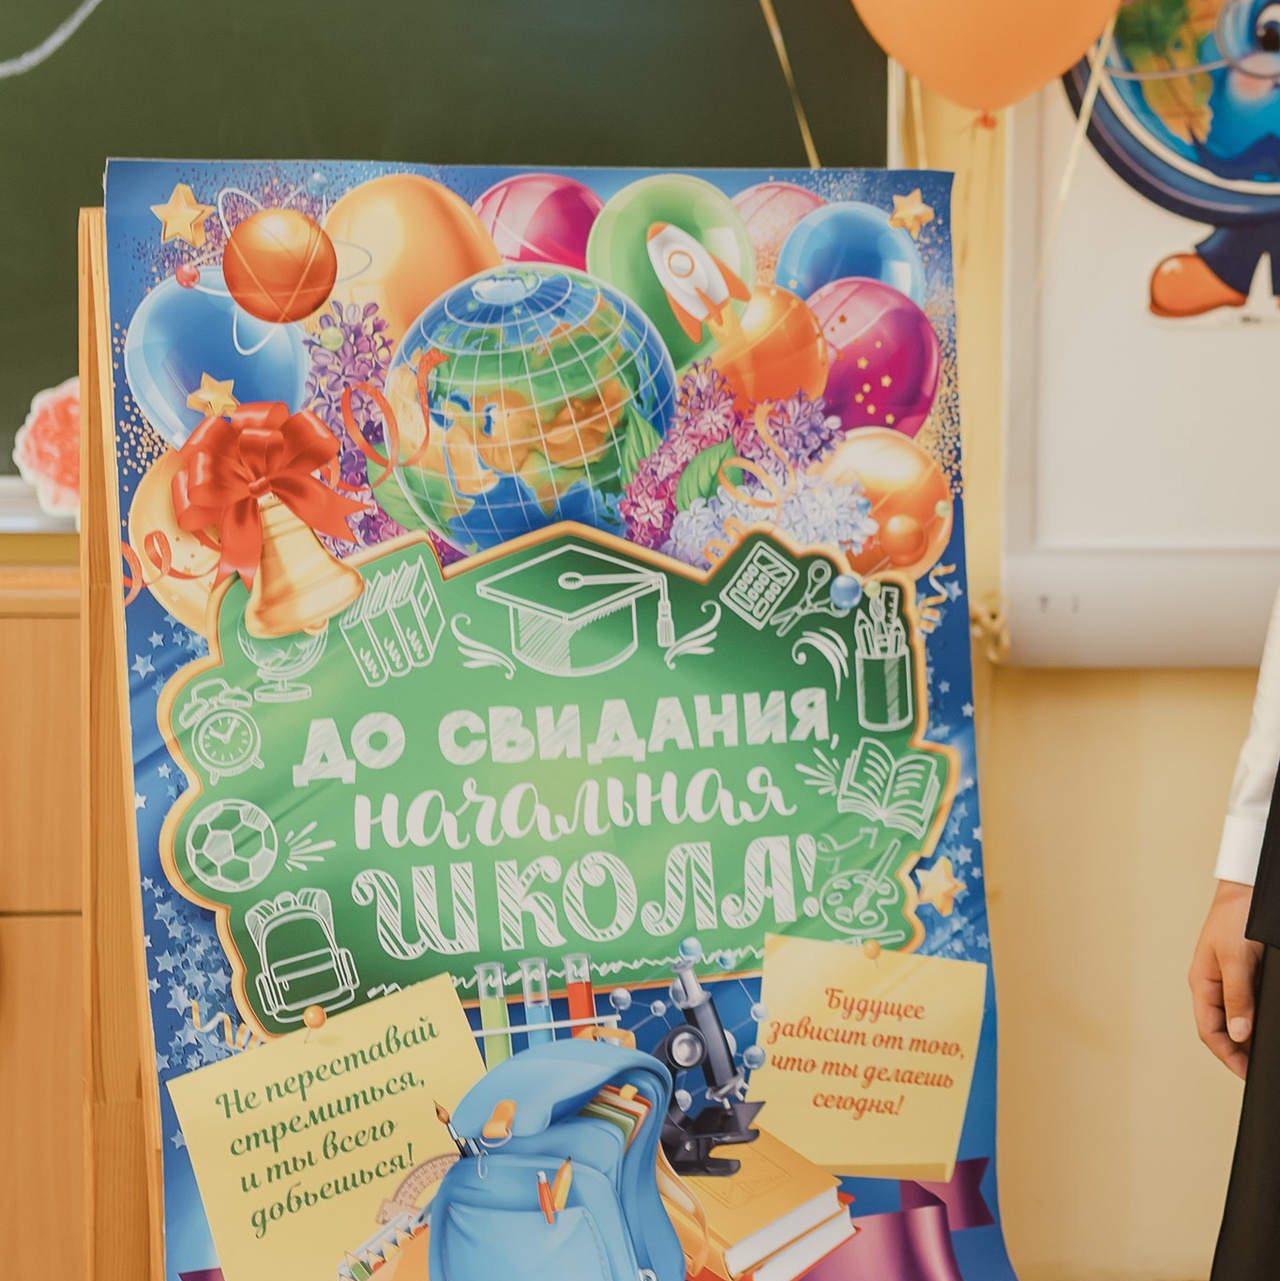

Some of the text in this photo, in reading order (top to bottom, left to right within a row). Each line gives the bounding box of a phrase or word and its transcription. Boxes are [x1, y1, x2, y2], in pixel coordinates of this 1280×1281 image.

[292, 686, 841, 788] ДО СВИДАНИЯ,
[352, 765, 798, 851] начальная
[350, 833, 821, 961] ШКОЛА!
[766, 1015, 868, 1047] зависит
[871, 1033, 904, 1051] от
[824, 986, 927, 1024] Будущее
[214, 1016, 440, 1120] Не переставай
[770, 1052, 955, 1090] что ты делаешь
[812, 1091, 906, 1121] сегодня!
[229, 1070, 426, 1154] стремиться,
[240, 1118, 399, 1193] и ты всего
